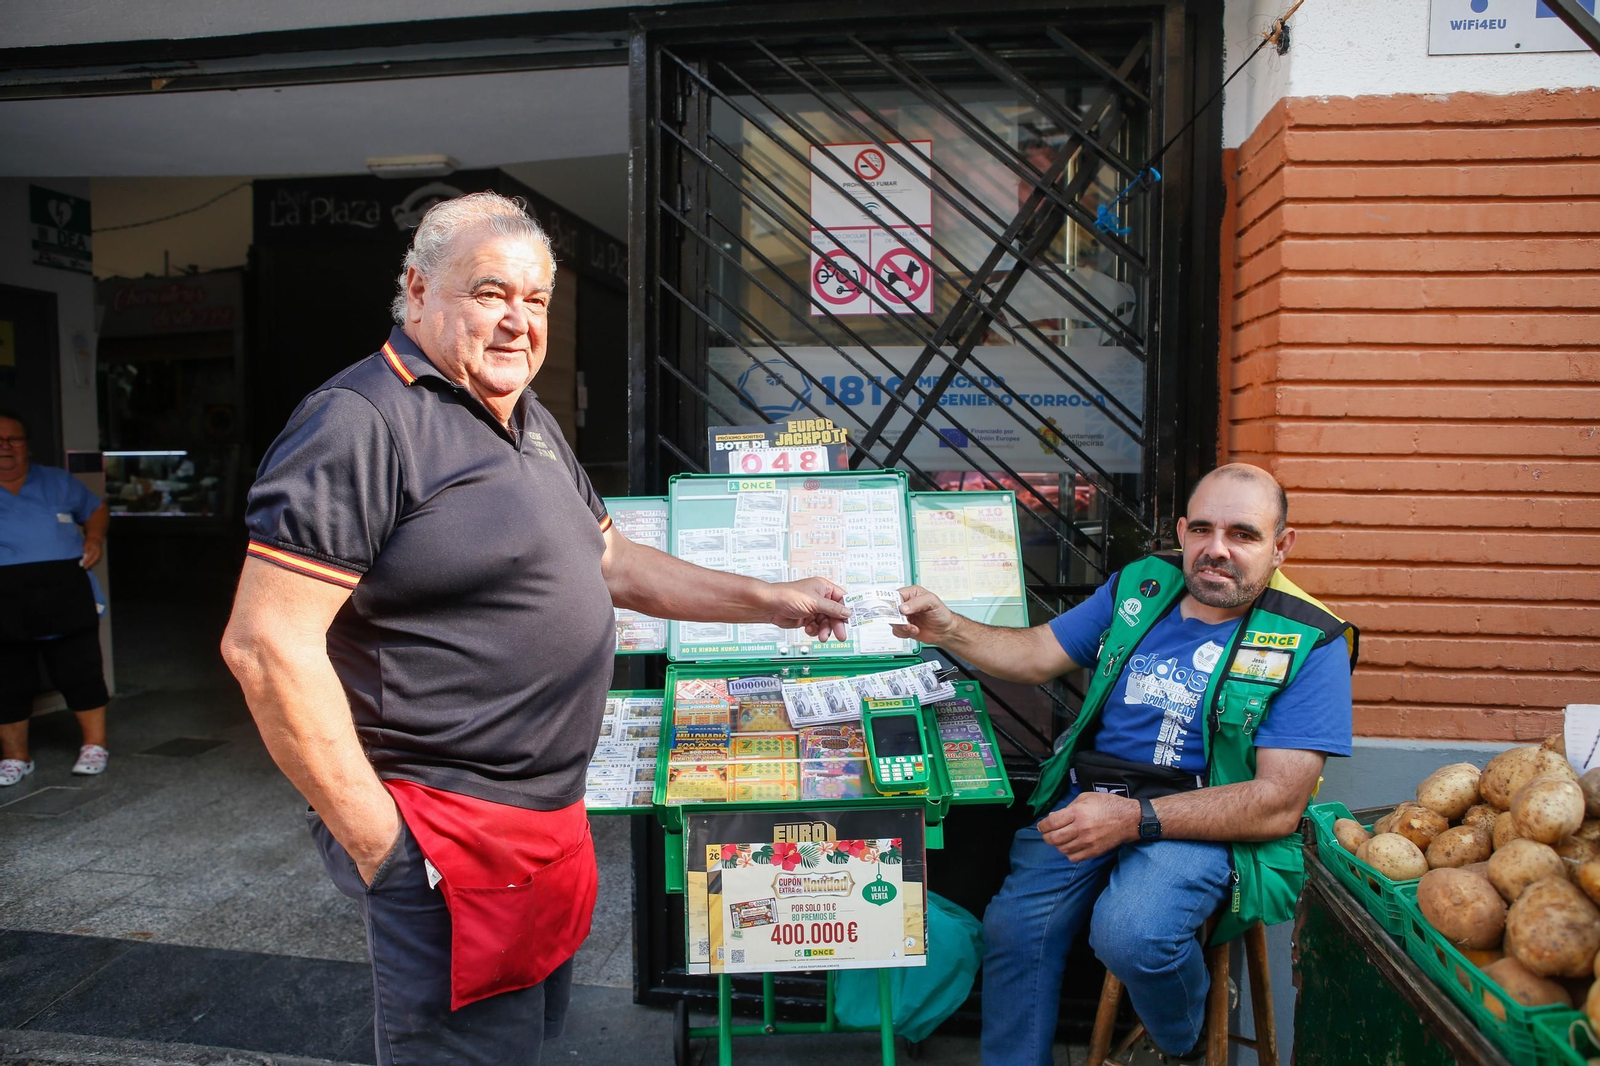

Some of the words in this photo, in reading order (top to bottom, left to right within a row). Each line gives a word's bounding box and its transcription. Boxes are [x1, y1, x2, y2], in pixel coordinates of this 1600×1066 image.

[1450, 18, 1507, 30] WiFi4EU
[310, 197, 382, 229] Plaza
[57, 230, 86, 250] DEA
[918, 394, 1013, 406] IGENIERO
[788, 418, 826, 433] EURO
[716, 441, 749, 450] BOTE
[751, 440, 770, 449] DE
[775, 429, 841, 446] JACKPOT
[1257, 635, 1295, 645] ONCE
[1129, 652, 1208, 693] didas
[1143, 692, 1196, 720] SPORTWEAR
[774, 823, 825, 842] EURO
[779, 876, 802, 886] CUPÓN
[804, 876, 848, 892] Navidad
[792, 904, 804, 912] POR
[805, 904, 821, 912] SOLO
[822, 903, 830, 911] 10
[801, 913, 827, 921] PREMIOS
